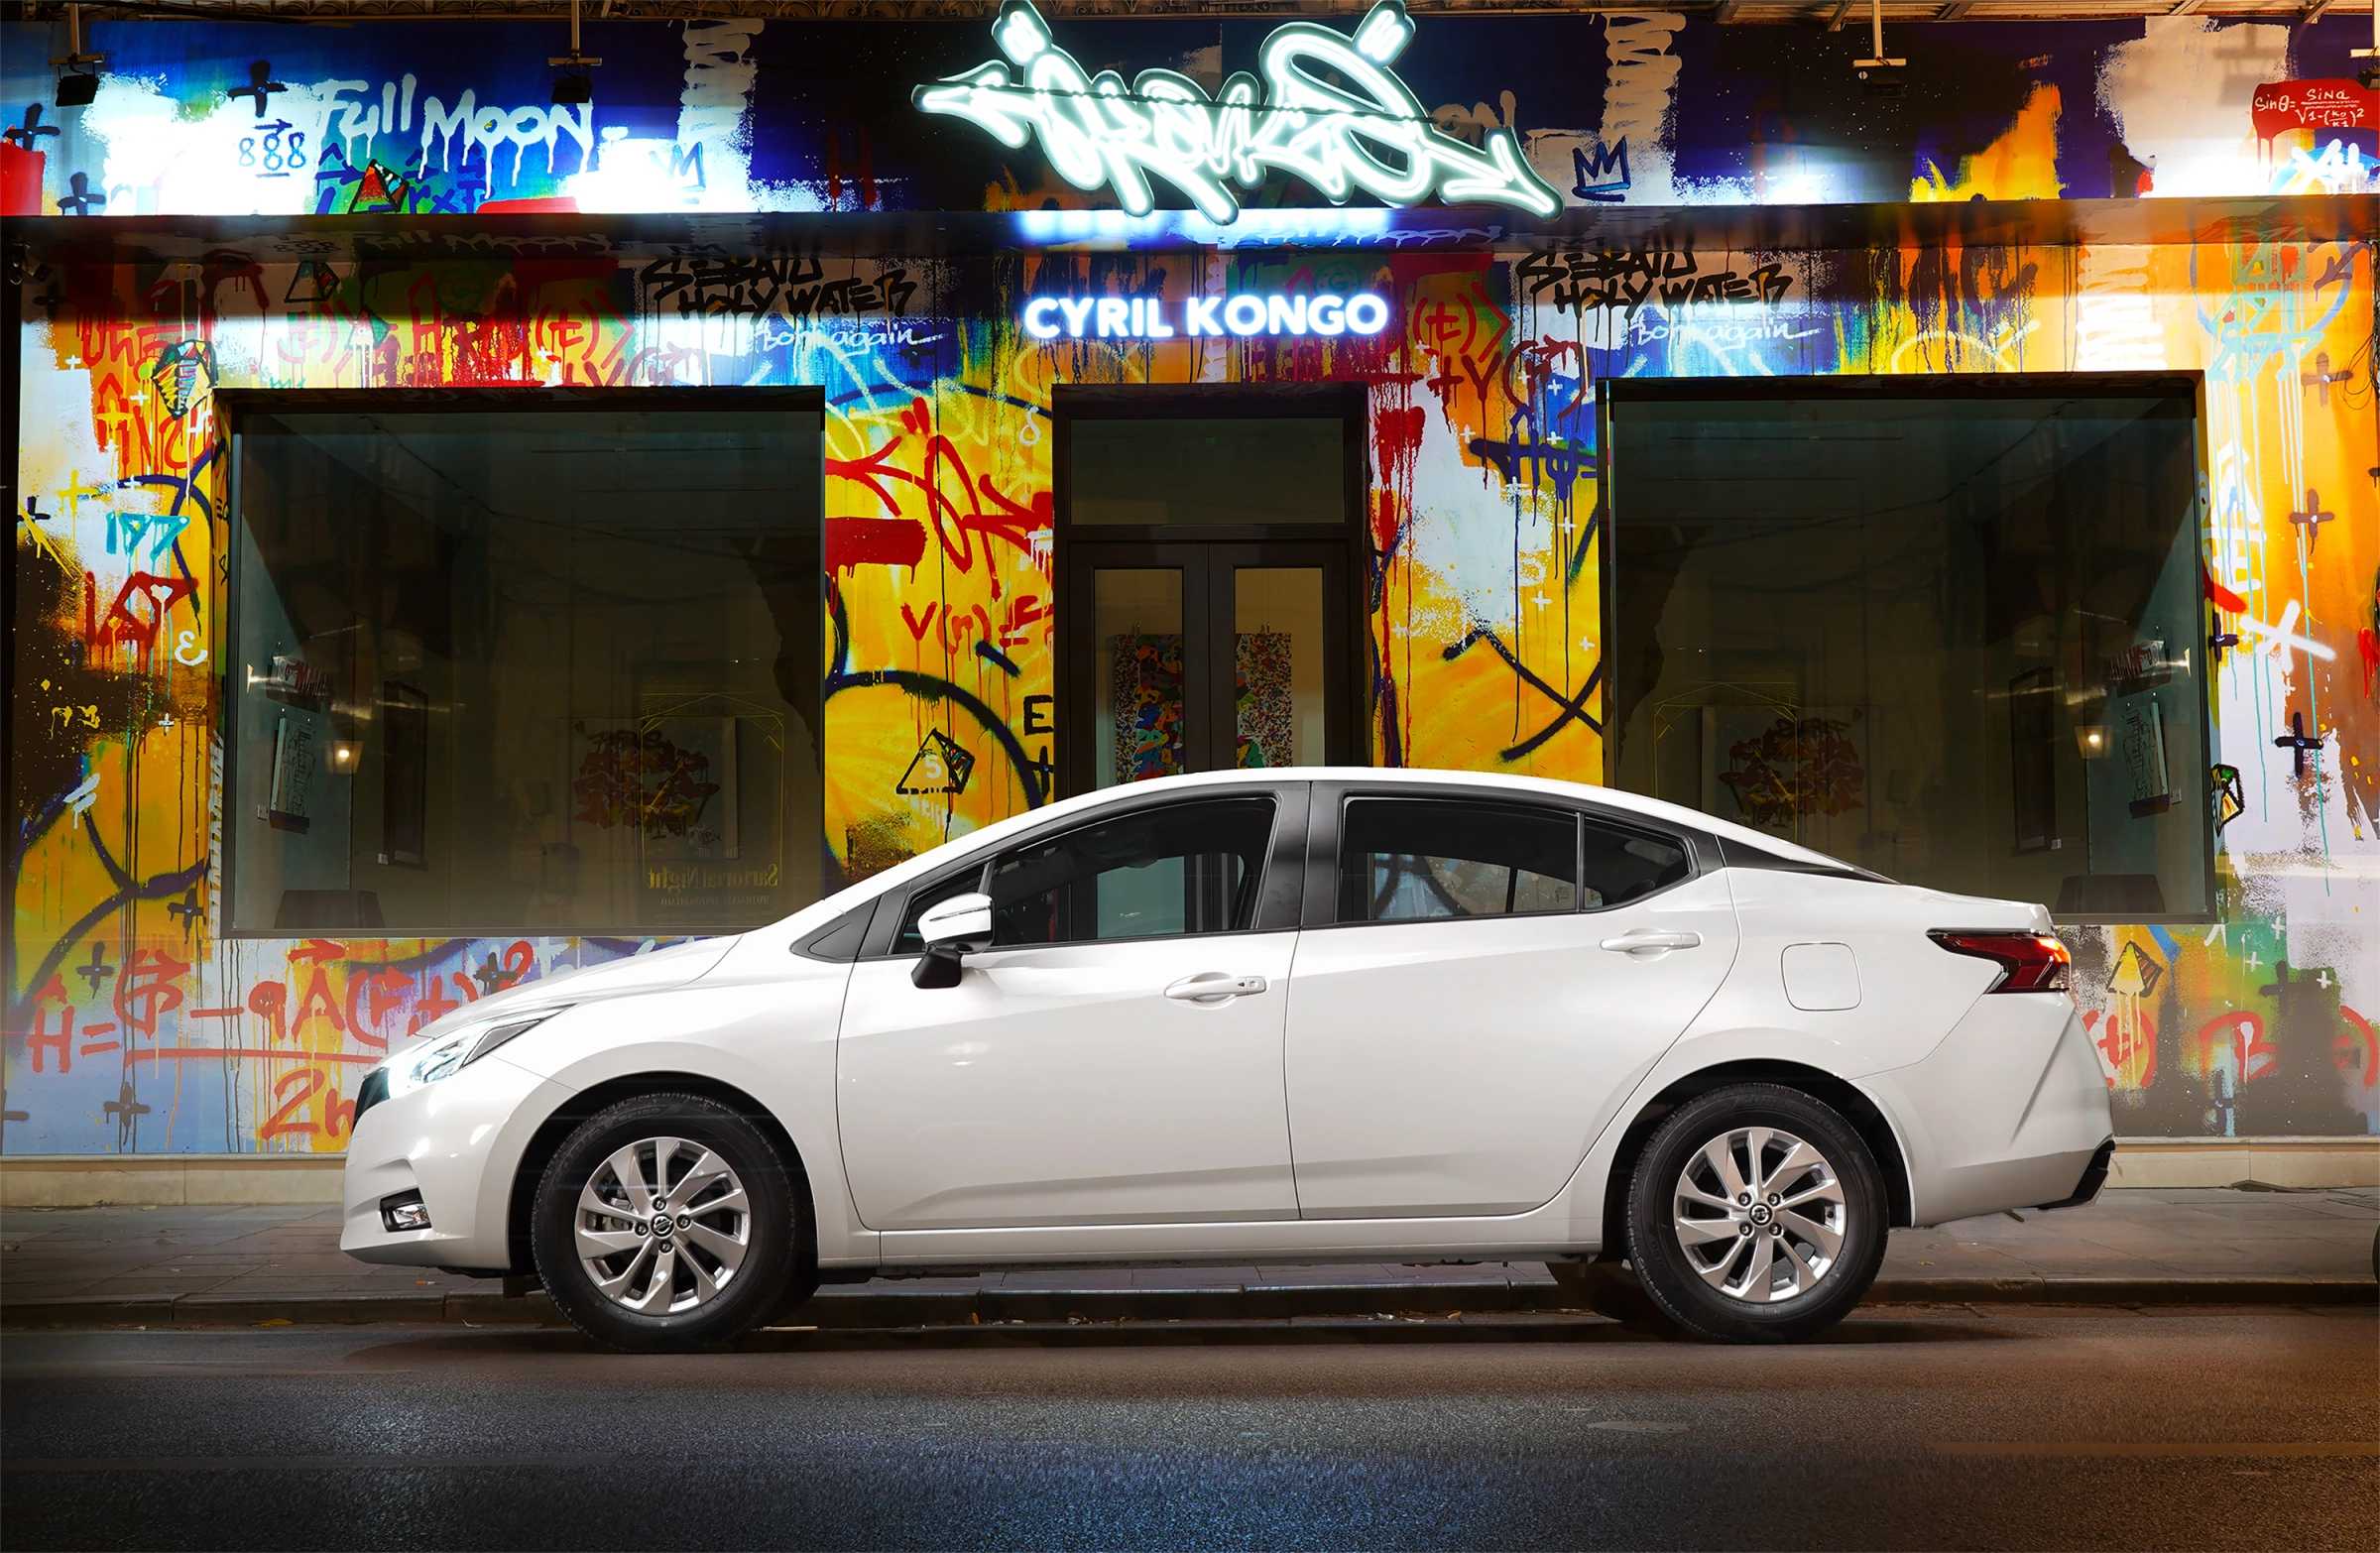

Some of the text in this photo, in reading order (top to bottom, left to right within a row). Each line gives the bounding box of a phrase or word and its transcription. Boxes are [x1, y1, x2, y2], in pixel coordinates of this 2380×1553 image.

[784, 269, 917, 317] WATER
[1658, 263, 1793, 310] WATER
[1024, 294, 1388, 338] CYRIL KONGO
